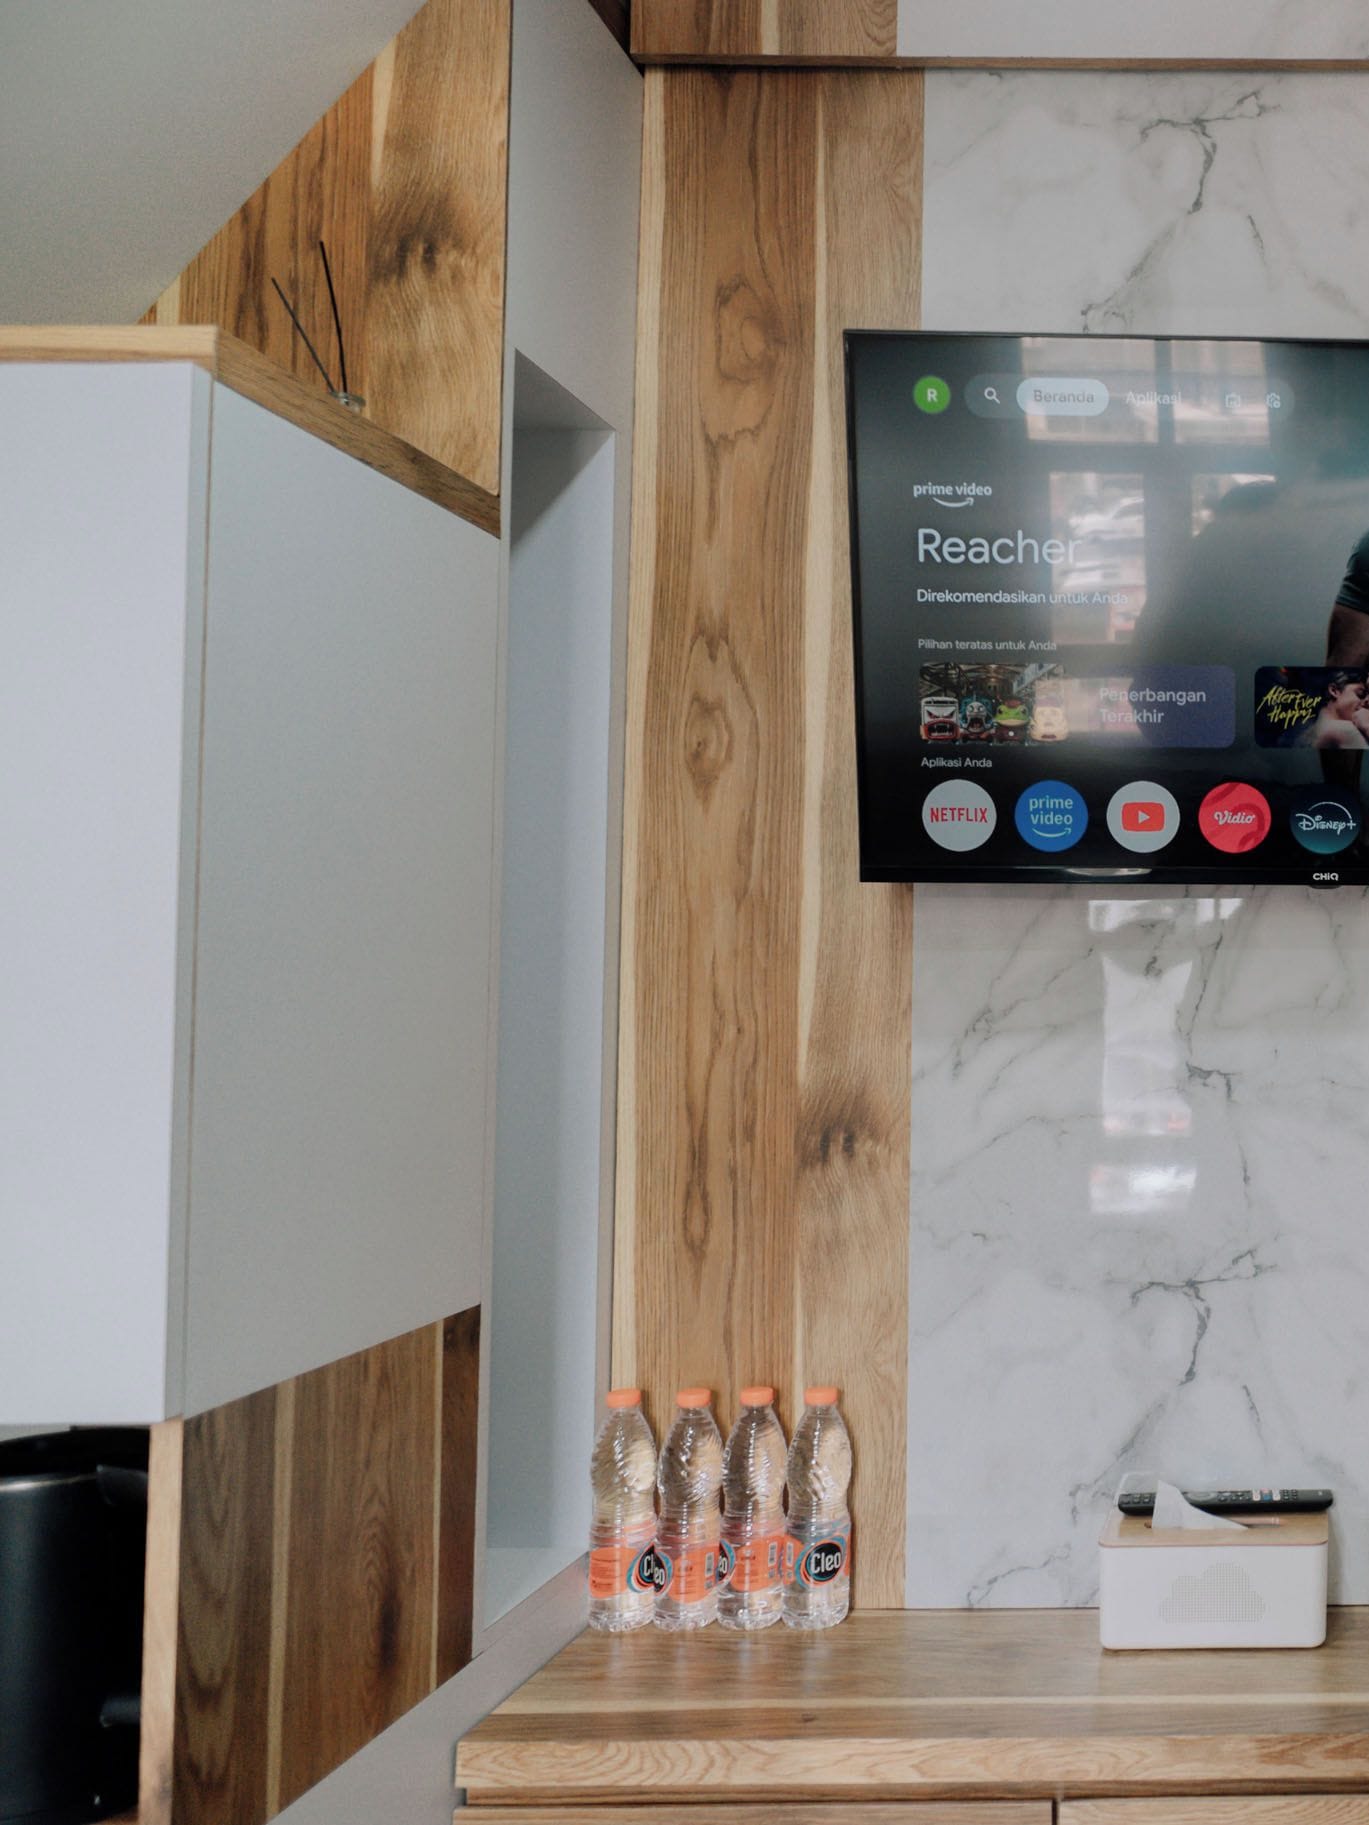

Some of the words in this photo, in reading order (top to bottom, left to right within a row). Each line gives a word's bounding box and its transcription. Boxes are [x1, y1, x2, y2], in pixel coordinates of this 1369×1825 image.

[926, 388, 938, 403] R
[1033, 389, 1095, 404] Beranda
[1125, 390, 1182, 407] Aplikasi
[912, 482, 953, 499] prime
[955, 482, 993, 497] video
[917, 527, 1081, 565] Reacher
[916, 588, 1047, 604] Direkomendasikan
[1050, 590, 1089, 604] untuk
[1092, 590, 1129, 605] Anda
[917, 638, 953, 649] Pilihan
[956, 639, 993, 650] teratas
[996, 640, 1026, 650] untuk
[1028, 640, 1057, 651] Anda
[1099, 687, 1207, 705] Penerbangan
[1256, 685, 1299, 714] After
[1294, 691, 1323, 710] Ever
[1100, 708, 1165, 724] Terakhir
[1267, 704, 1317, 730] Happy
[920, 756, 962, 769] Aplikasi
[964, 756, 993, 768] Anda
[1028, 796, 1074, 813] prime
[929, 806, 989, 824] NETFLIX
[1030, 810, 1074, 826] video
[1213, 810, 1256, 825] Vidio
[810, 1551, 842, 1574] Cleo
